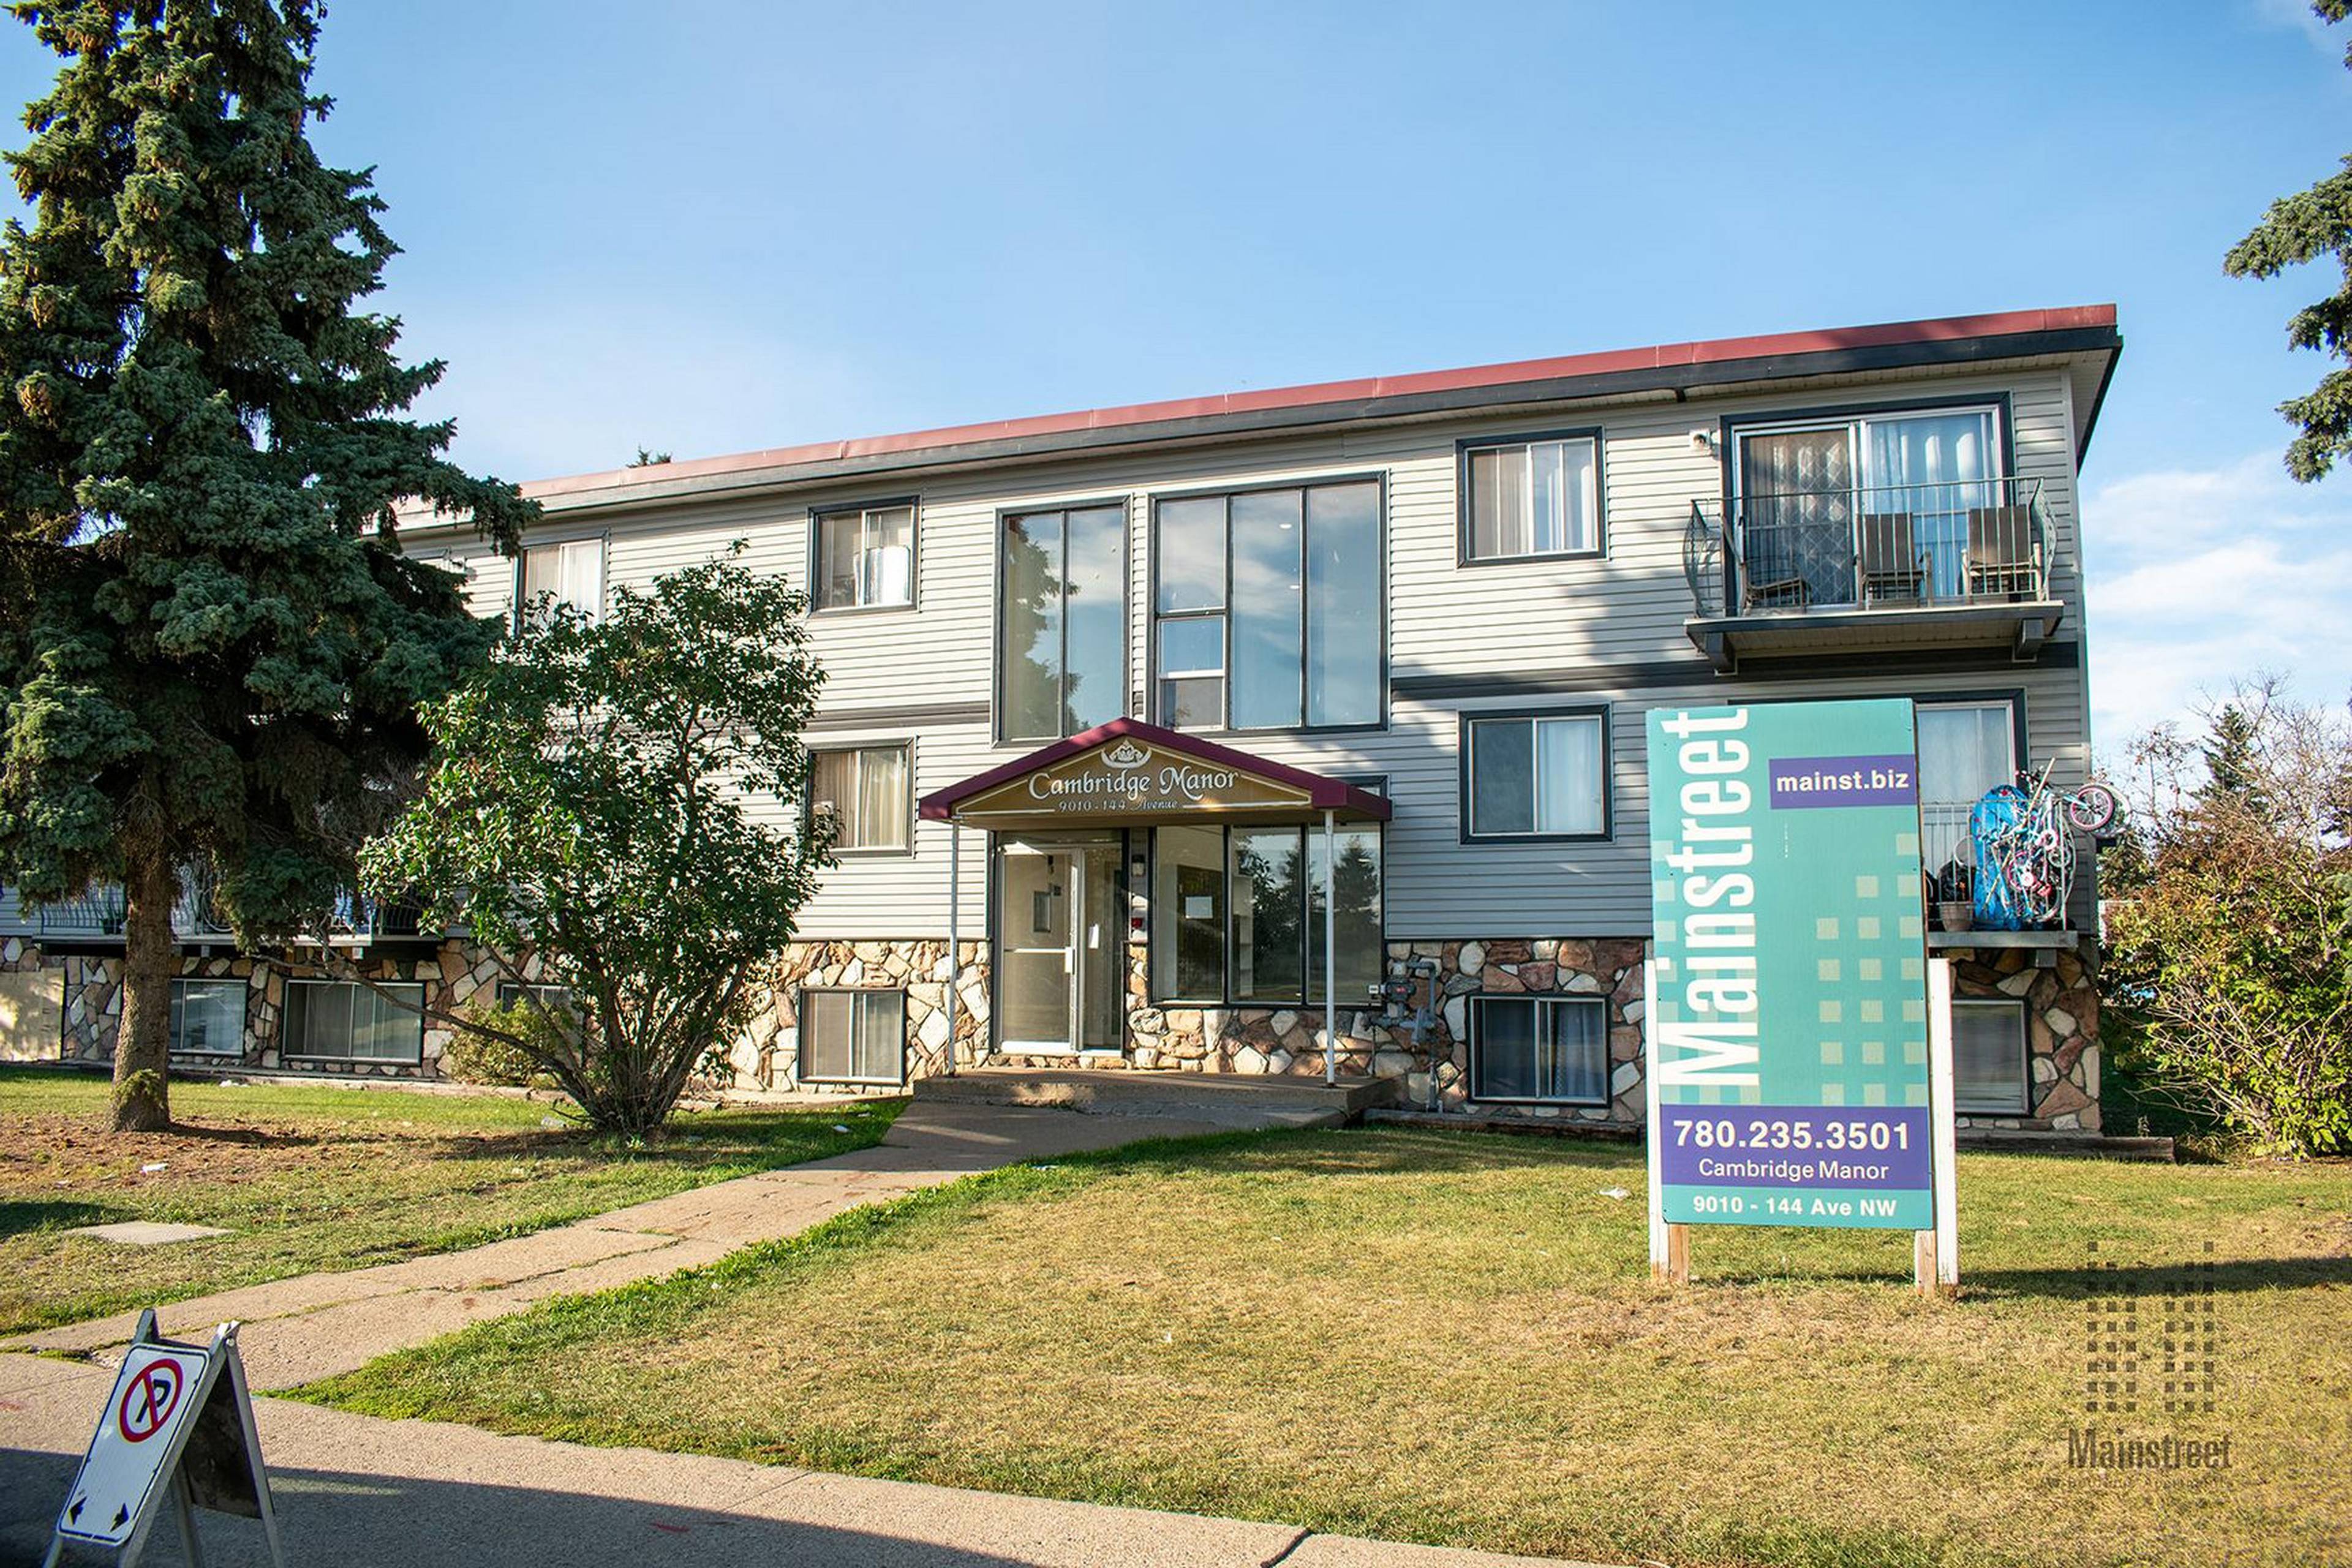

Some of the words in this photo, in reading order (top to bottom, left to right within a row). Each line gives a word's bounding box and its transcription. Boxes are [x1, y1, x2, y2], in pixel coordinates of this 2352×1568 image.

[1029, 769, 1151, 801] Cambridge
[1159, 766, 1238, 800] Manor
[1776, 769, 1910, 792] mainst.biz
[1058, 801, 1091, 812] 9010
[1102, 799, 1126, 811] 144
[1655, 708, 1760, 1085] Mainstreet
[1673, 1120, 1908, 1150] 780.235.3501
[1699, 1158, 1814, 1182] Cambridge
[1819, 1161, 1889, 1180] Manor
[1693, 1196, 1743, 1213] 9010
[1766, 1197, 1803, 1213] 144
[1811, 1199, 1852, 1216] Ave
[1860, 1200, 1896, 1216] NW
